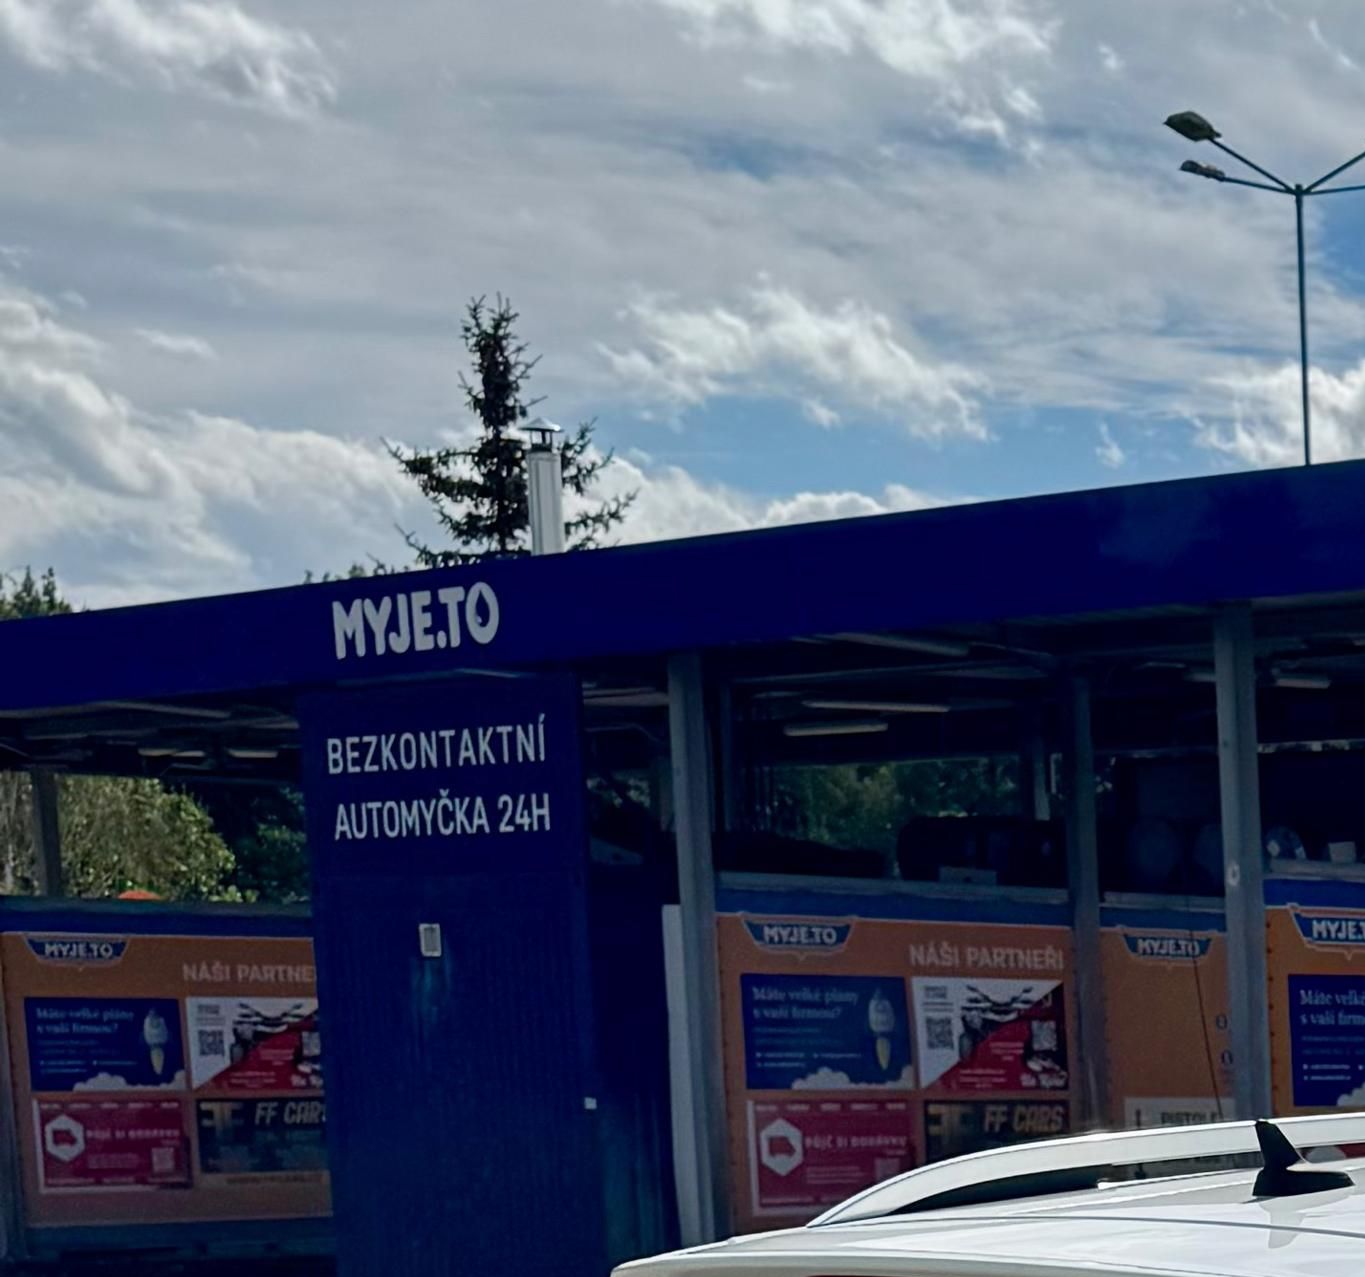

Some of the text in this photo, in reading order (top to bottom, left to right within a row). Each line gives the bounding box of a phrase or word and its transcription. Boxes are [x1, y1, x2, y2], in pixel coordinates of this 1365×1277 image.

[332, 581, 500, 659] MYJE.TO
[327, 713, 547, 775] BEZKONTAKTNÍ
[334, 788, 550, 841] AUTOMYČKA 24H
[763, 925, 837, 944] MYJE.TO
[236, 963, 316, 984] PARTNE
[984, 1104, 1007, 1132] FF
